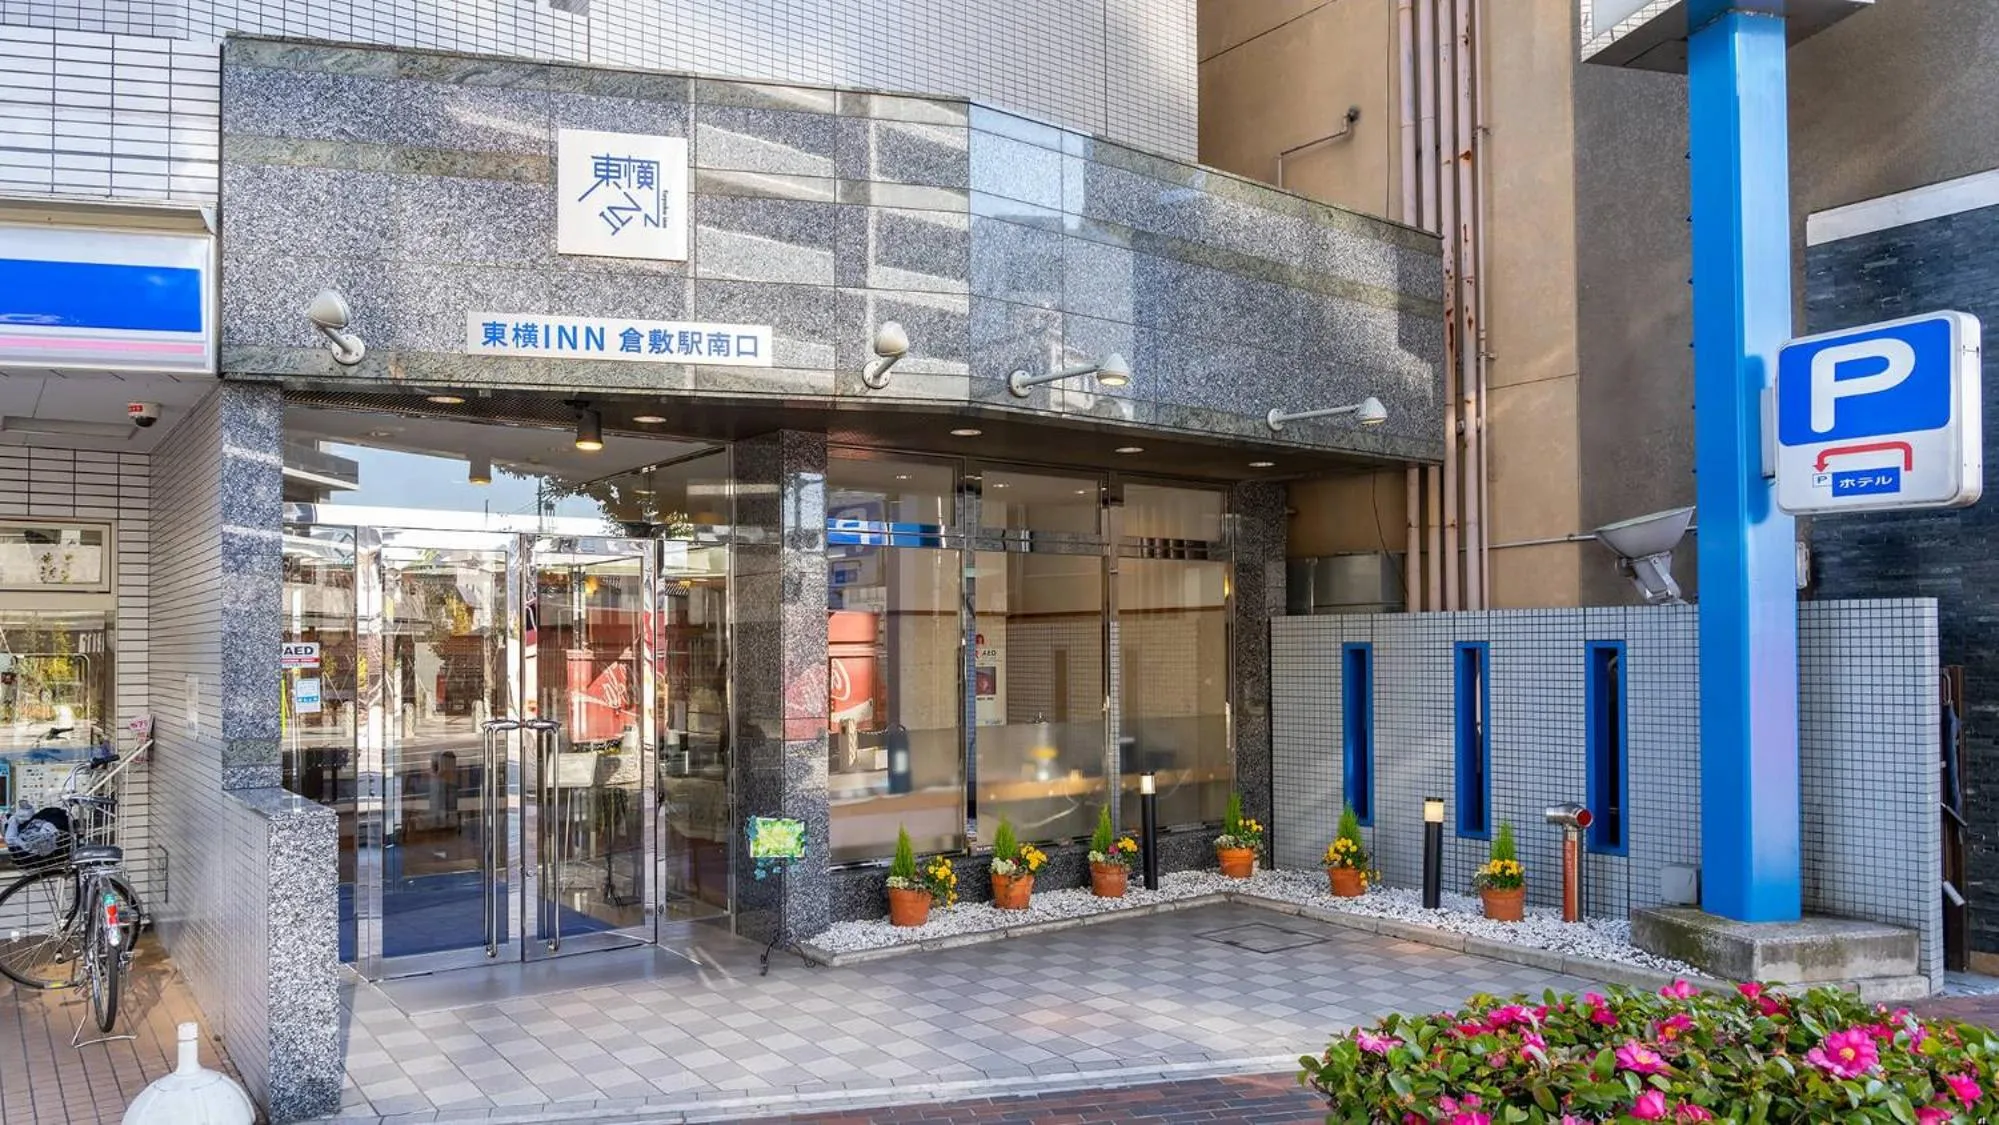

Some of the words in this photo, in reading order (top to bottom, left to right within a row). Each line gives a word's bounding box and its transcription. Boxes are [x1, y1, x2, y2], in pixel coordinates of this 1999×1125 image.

[481, 321, 605, 351] 東横INN
[619, 327, 759, 358] 倉敷駅南口
[1811, 338, 1916, 433] P
[1817, 475, 1828, 484] P
[1839, 474, 1893, 489] ホテル
[283, 645, 314, 655] AED
